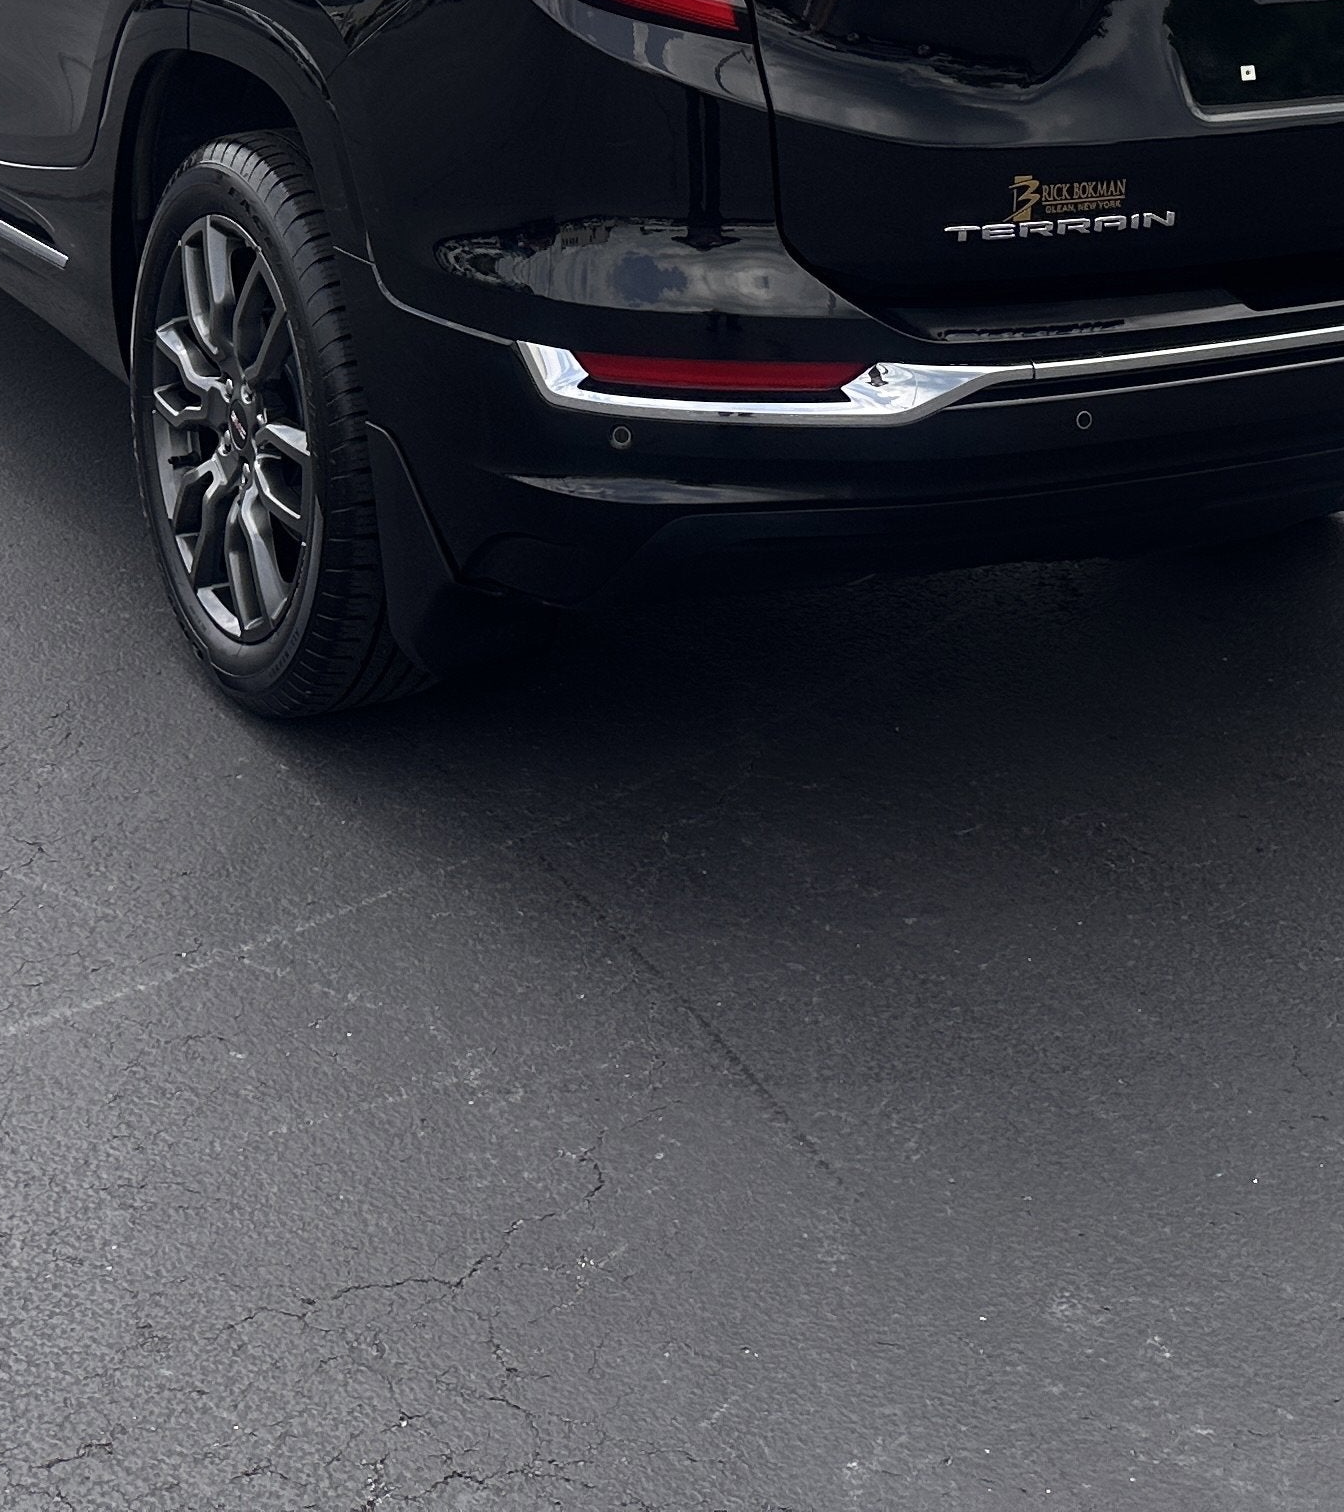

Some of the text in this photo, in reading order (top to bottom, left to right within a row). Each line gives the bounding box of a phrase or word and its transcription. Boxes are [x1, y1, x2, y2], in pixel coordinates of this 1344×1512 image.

[1041, 178, 1126, 201] RICK BOKMAN
[1077, 202, 1097, 211] NEW
[1098, 200, 1121, 209] YORK
[943, 210, 1176, 243] TERRAIN
